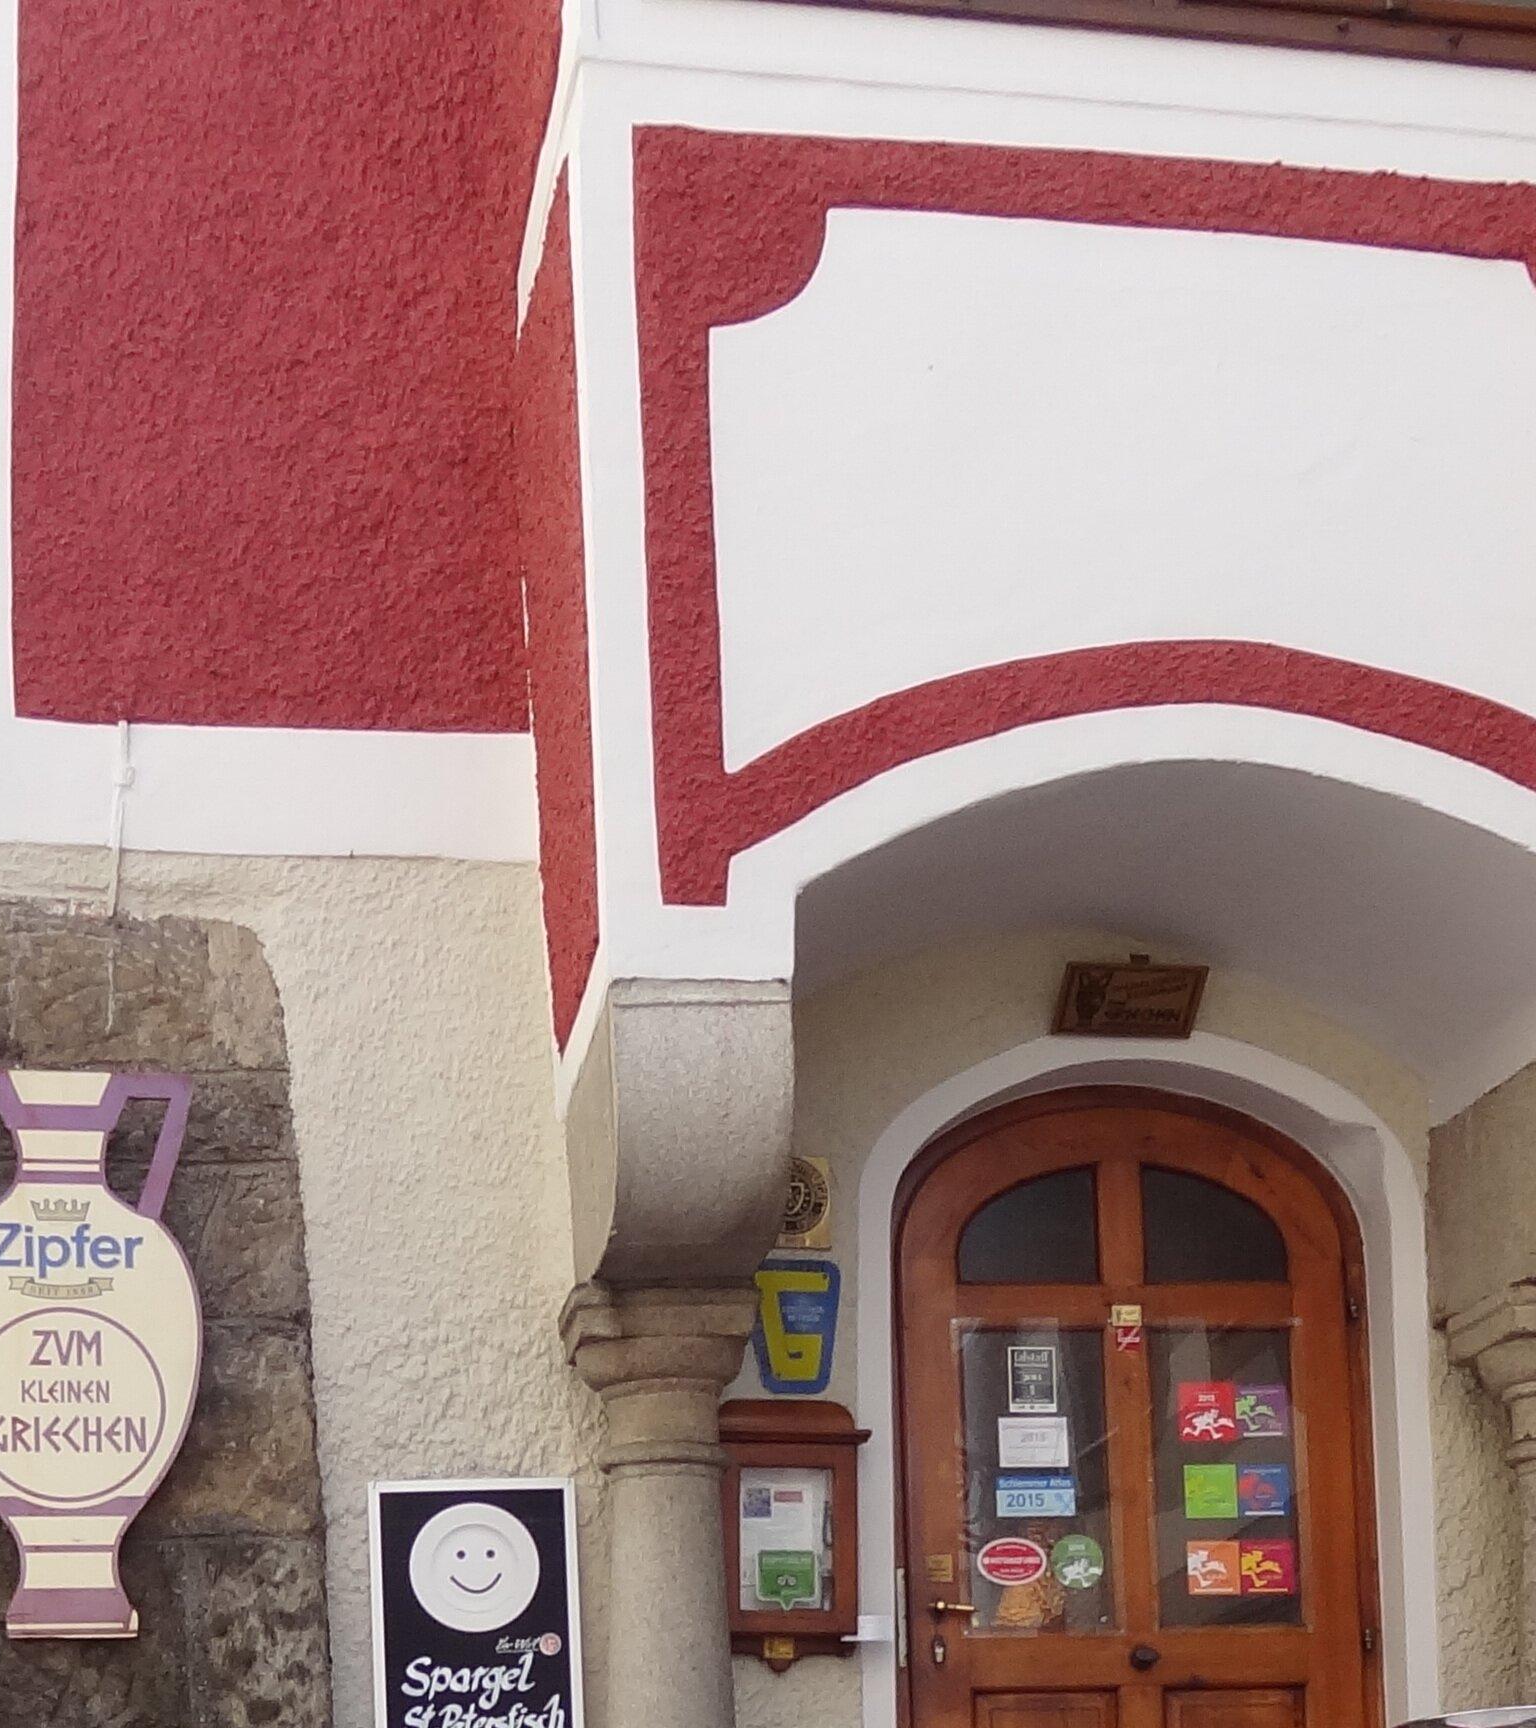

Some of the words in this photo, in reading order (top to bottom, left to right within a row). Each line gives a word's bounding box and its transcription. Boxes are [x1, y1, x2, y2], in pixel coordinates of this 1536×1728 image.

[20, 1379, 110, 1404] KLEINEN
[1005, 1492, 1046, 1508] 2015
[401, 1652, 536, 1710] Spargel
